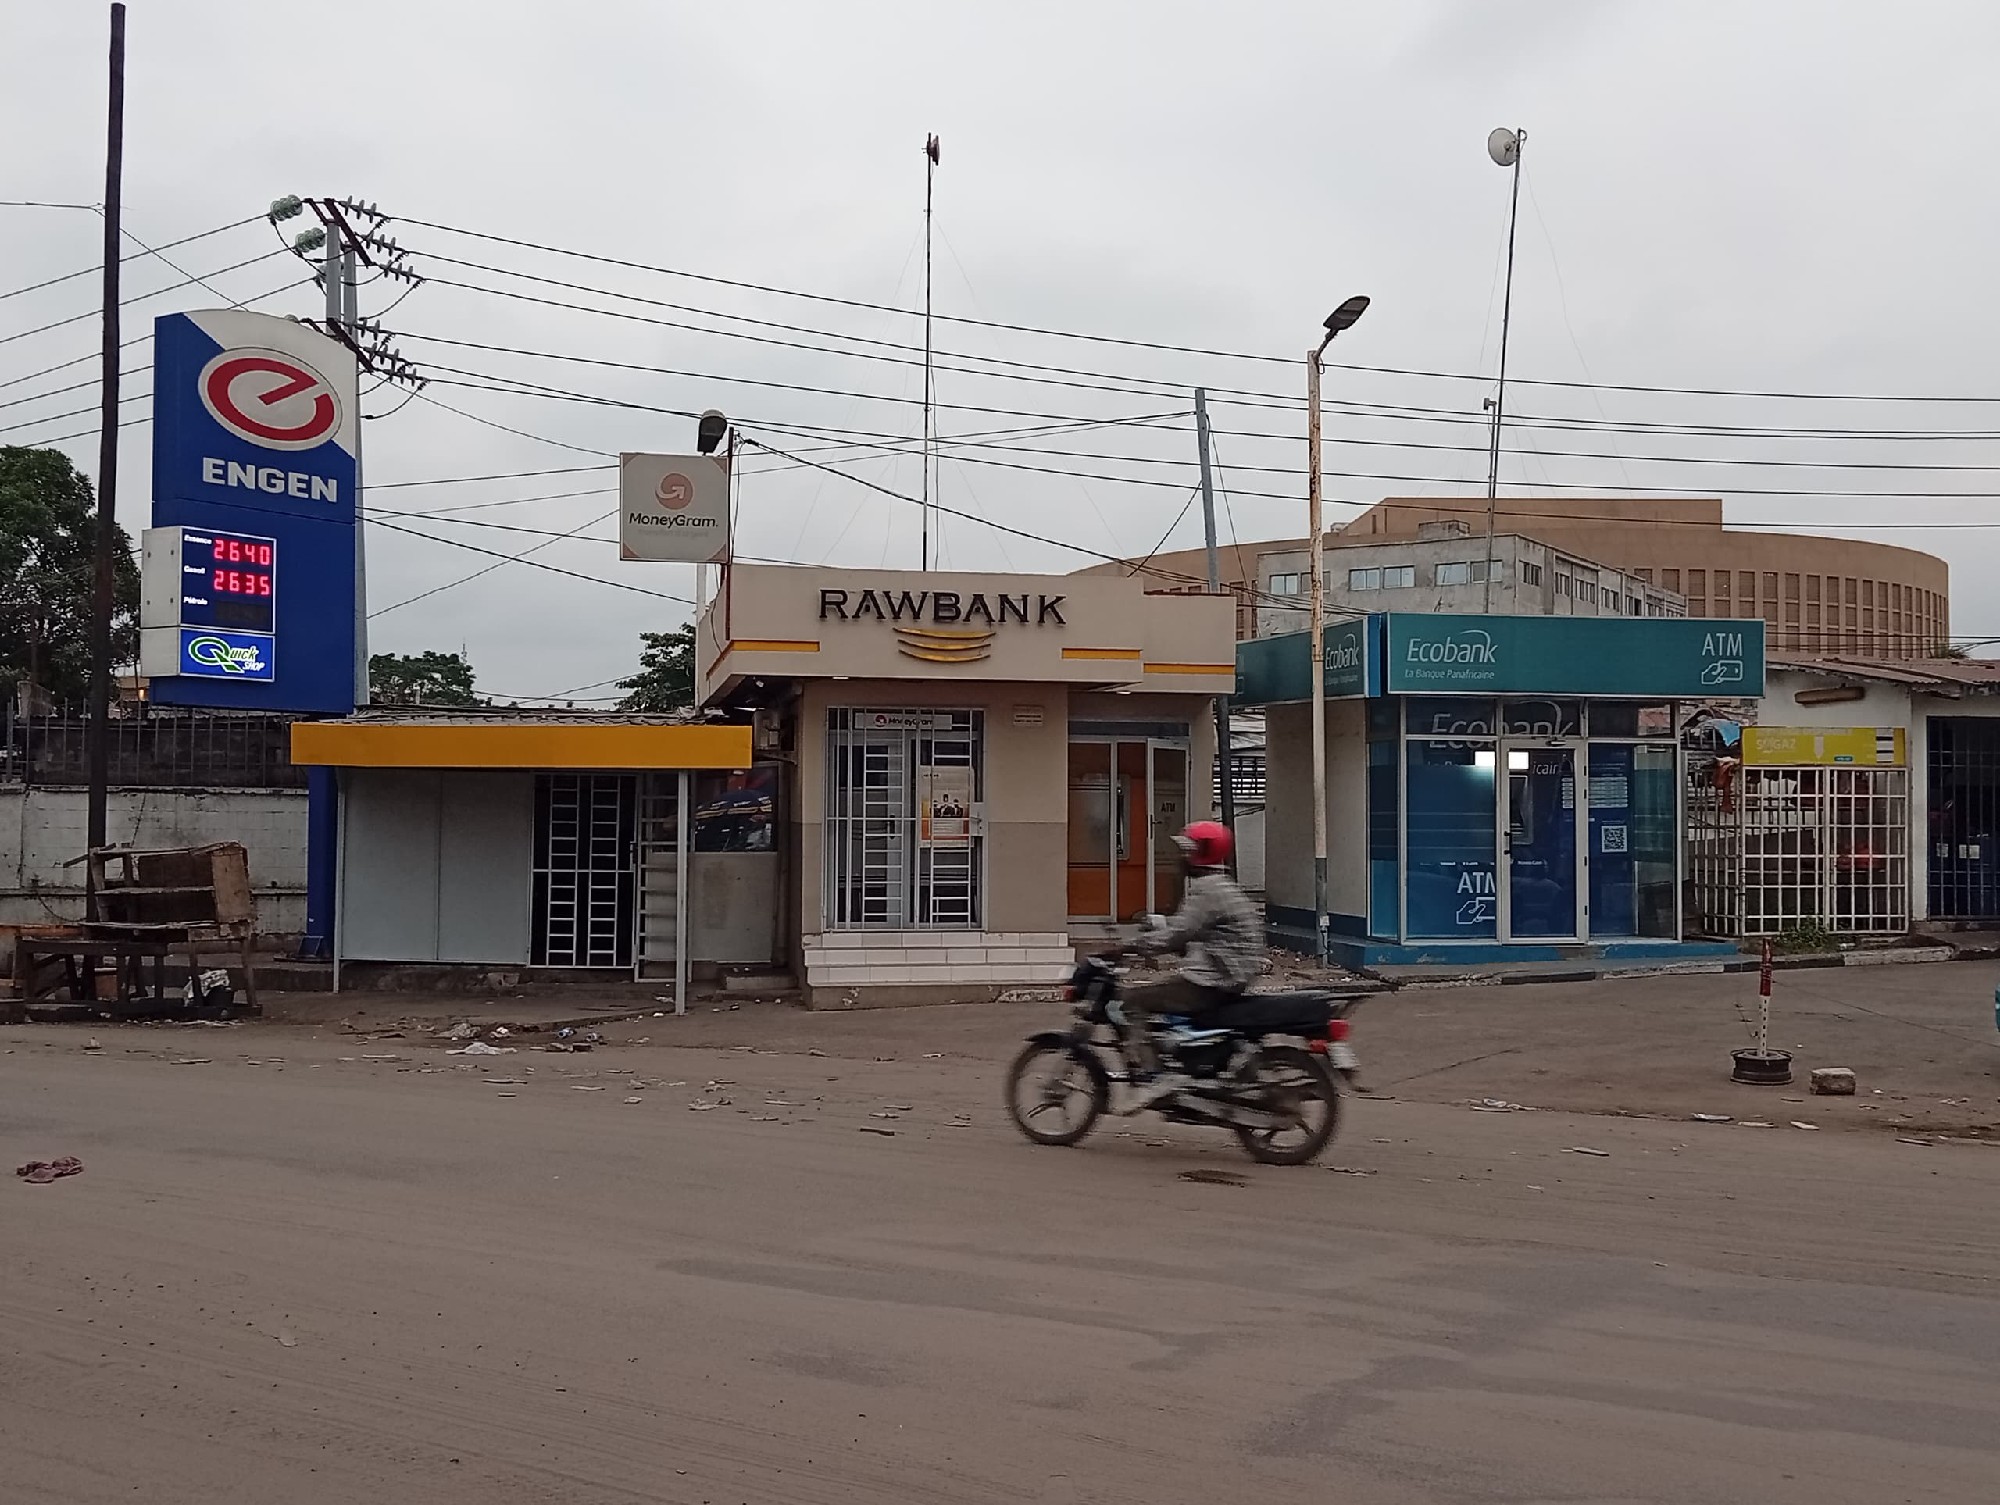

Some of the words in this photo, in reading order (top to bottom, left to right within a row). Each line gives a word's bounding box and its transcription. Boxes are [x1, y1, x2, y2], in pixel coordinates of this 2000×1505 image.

[202, 457, 338, 503] ENGEN
[213, 538, 271, 566] 2640
[213, 569, 271, 596] 2635
[819, 588, 1066, 624] RAWBANK
[1325, 633, 1360, 670] Ecobank
[1406, 629, 1498, 663] Ecobank
[1701, 632, 1742, 656] ATM
[242, 661, 265, 671] SHOP
[1404, 668, 1414, 679] La
[1415, 669, 1446, 679] Banque
[1446, 668, 1495, 680] Panafricaine
